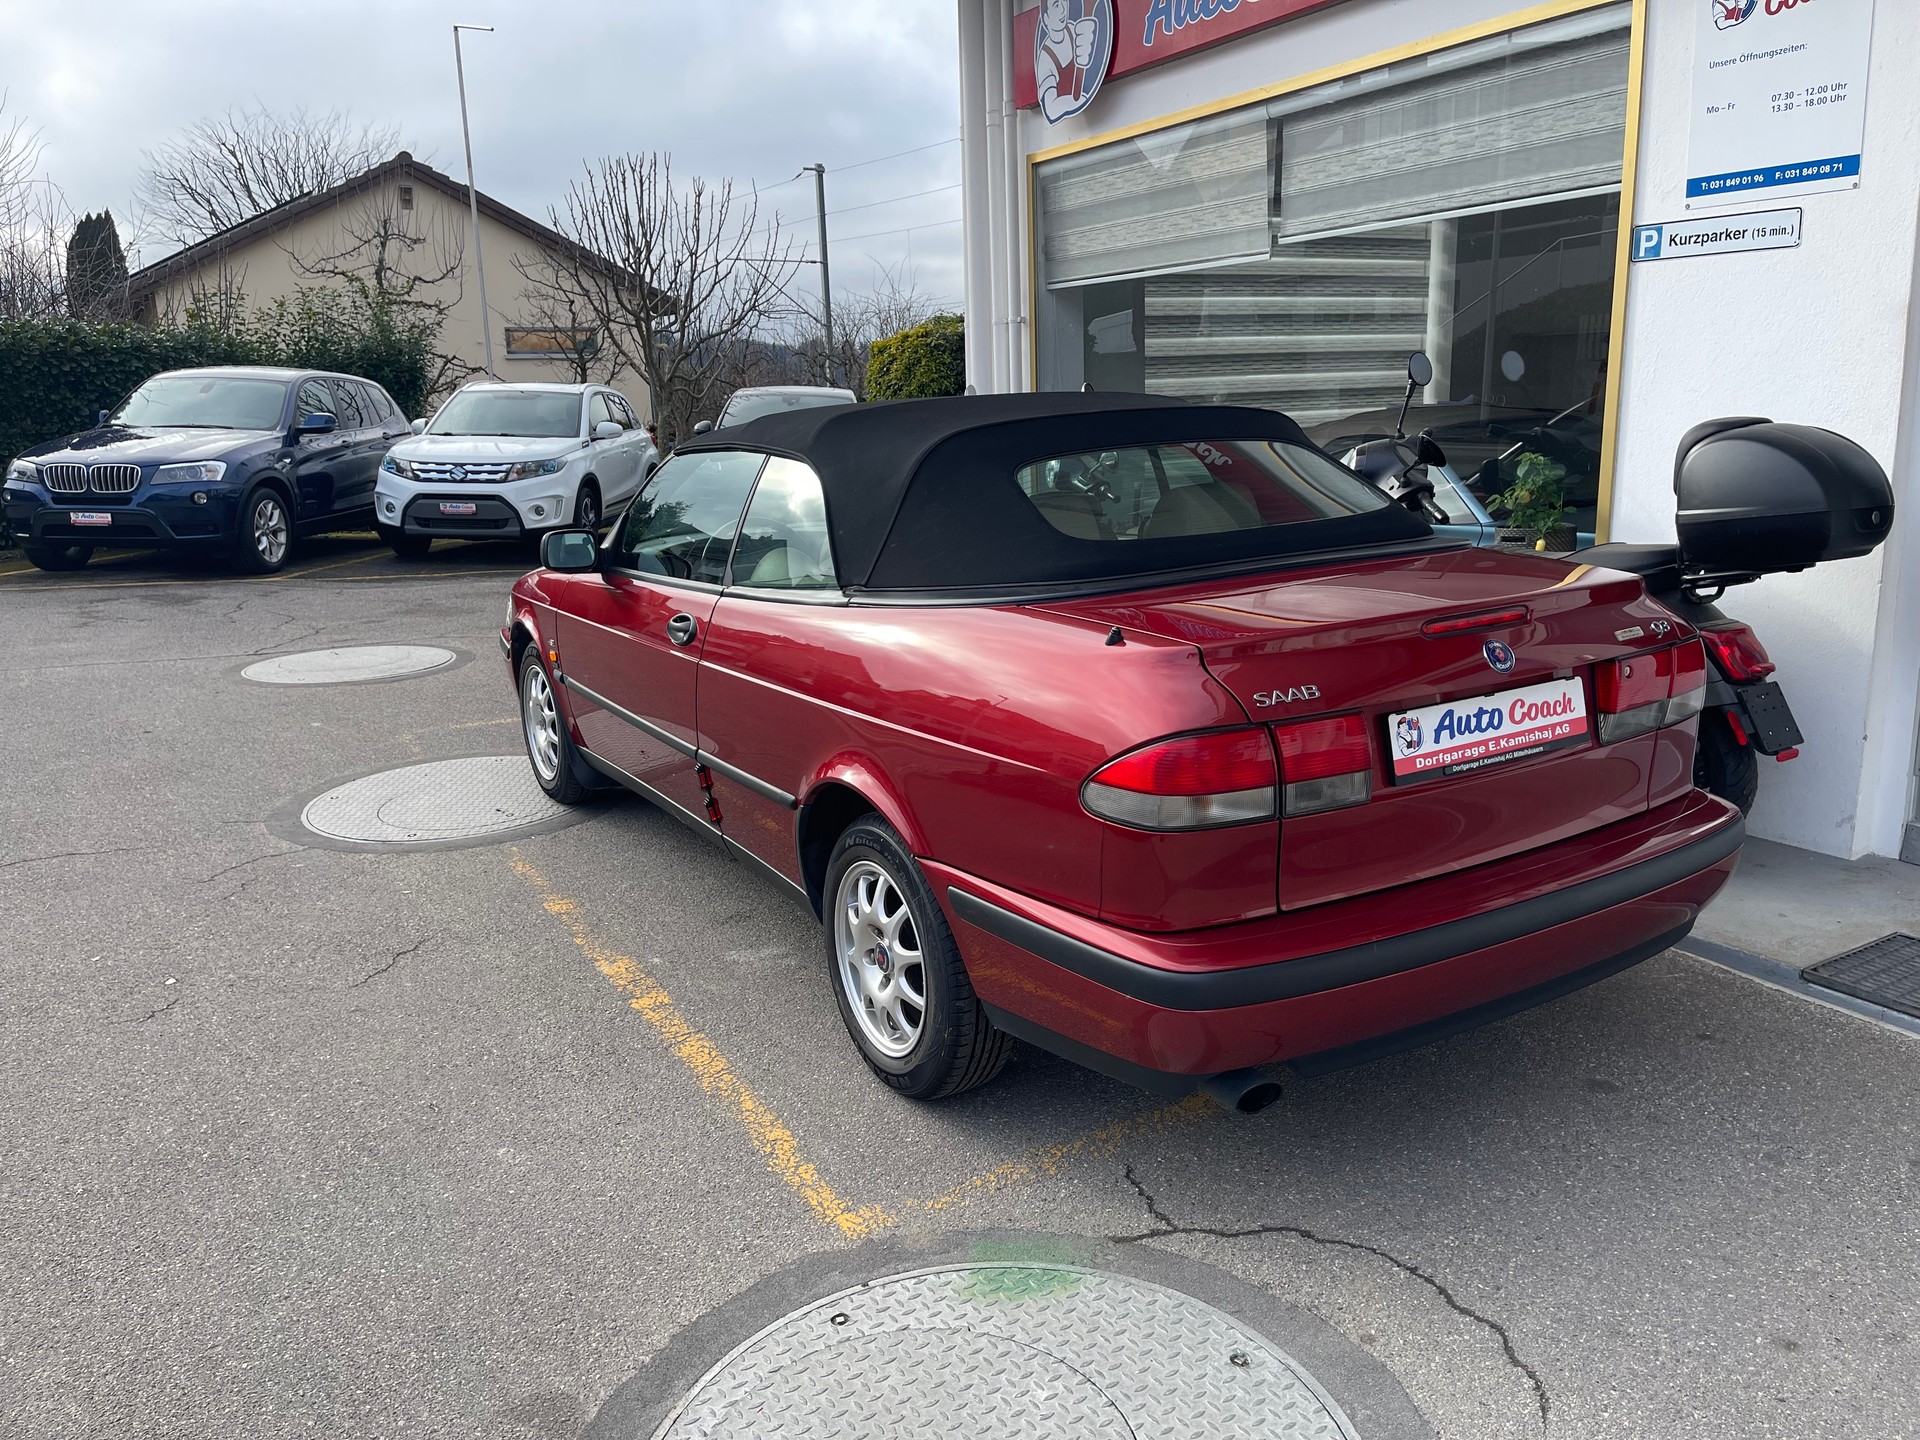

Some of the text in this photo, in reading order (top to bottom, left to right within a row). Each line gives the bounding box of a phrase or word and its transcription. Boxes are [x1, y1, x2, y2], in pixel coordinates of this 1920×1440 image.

[1143, 0, 1240, 46] Au
[1709, 42, 1808, 69] Unsere Öffnungszeiten:
[1771, 90, 1795, 103] 07.30
[1805, 84, 1828, 97] 12.00
[1830, 81, 1848, 94] Uhr
[1771, 101, 1794, 114] 13.30
[1804, 96, 1828, 108] 18.00
[1830, 92, 1847, 104] Uhr
[1706, 105, 1720, 114] Mo
[1727, 102, 1736, 111] Fr
[1701, 174, 1764, 191] T: 031 849 01 96
[1775, 163, 1843, 180] F: 031 849 08 71
[1668, 226, 1748, 247] Kurzparker
[1751, 227, 1767, 240] (15
[1769, 224, 1794, 238] min.)
[1253, 684, 1321, 707] SAAB
[1433, 692, 1576, 744] Auto Coach
[1416, 722, 1571, 769] Dorfgarage E.Kamishaj AG
[1452, 761, 1480, 772] Dorfgarage
[1505, 753, 1514, 761] AG
